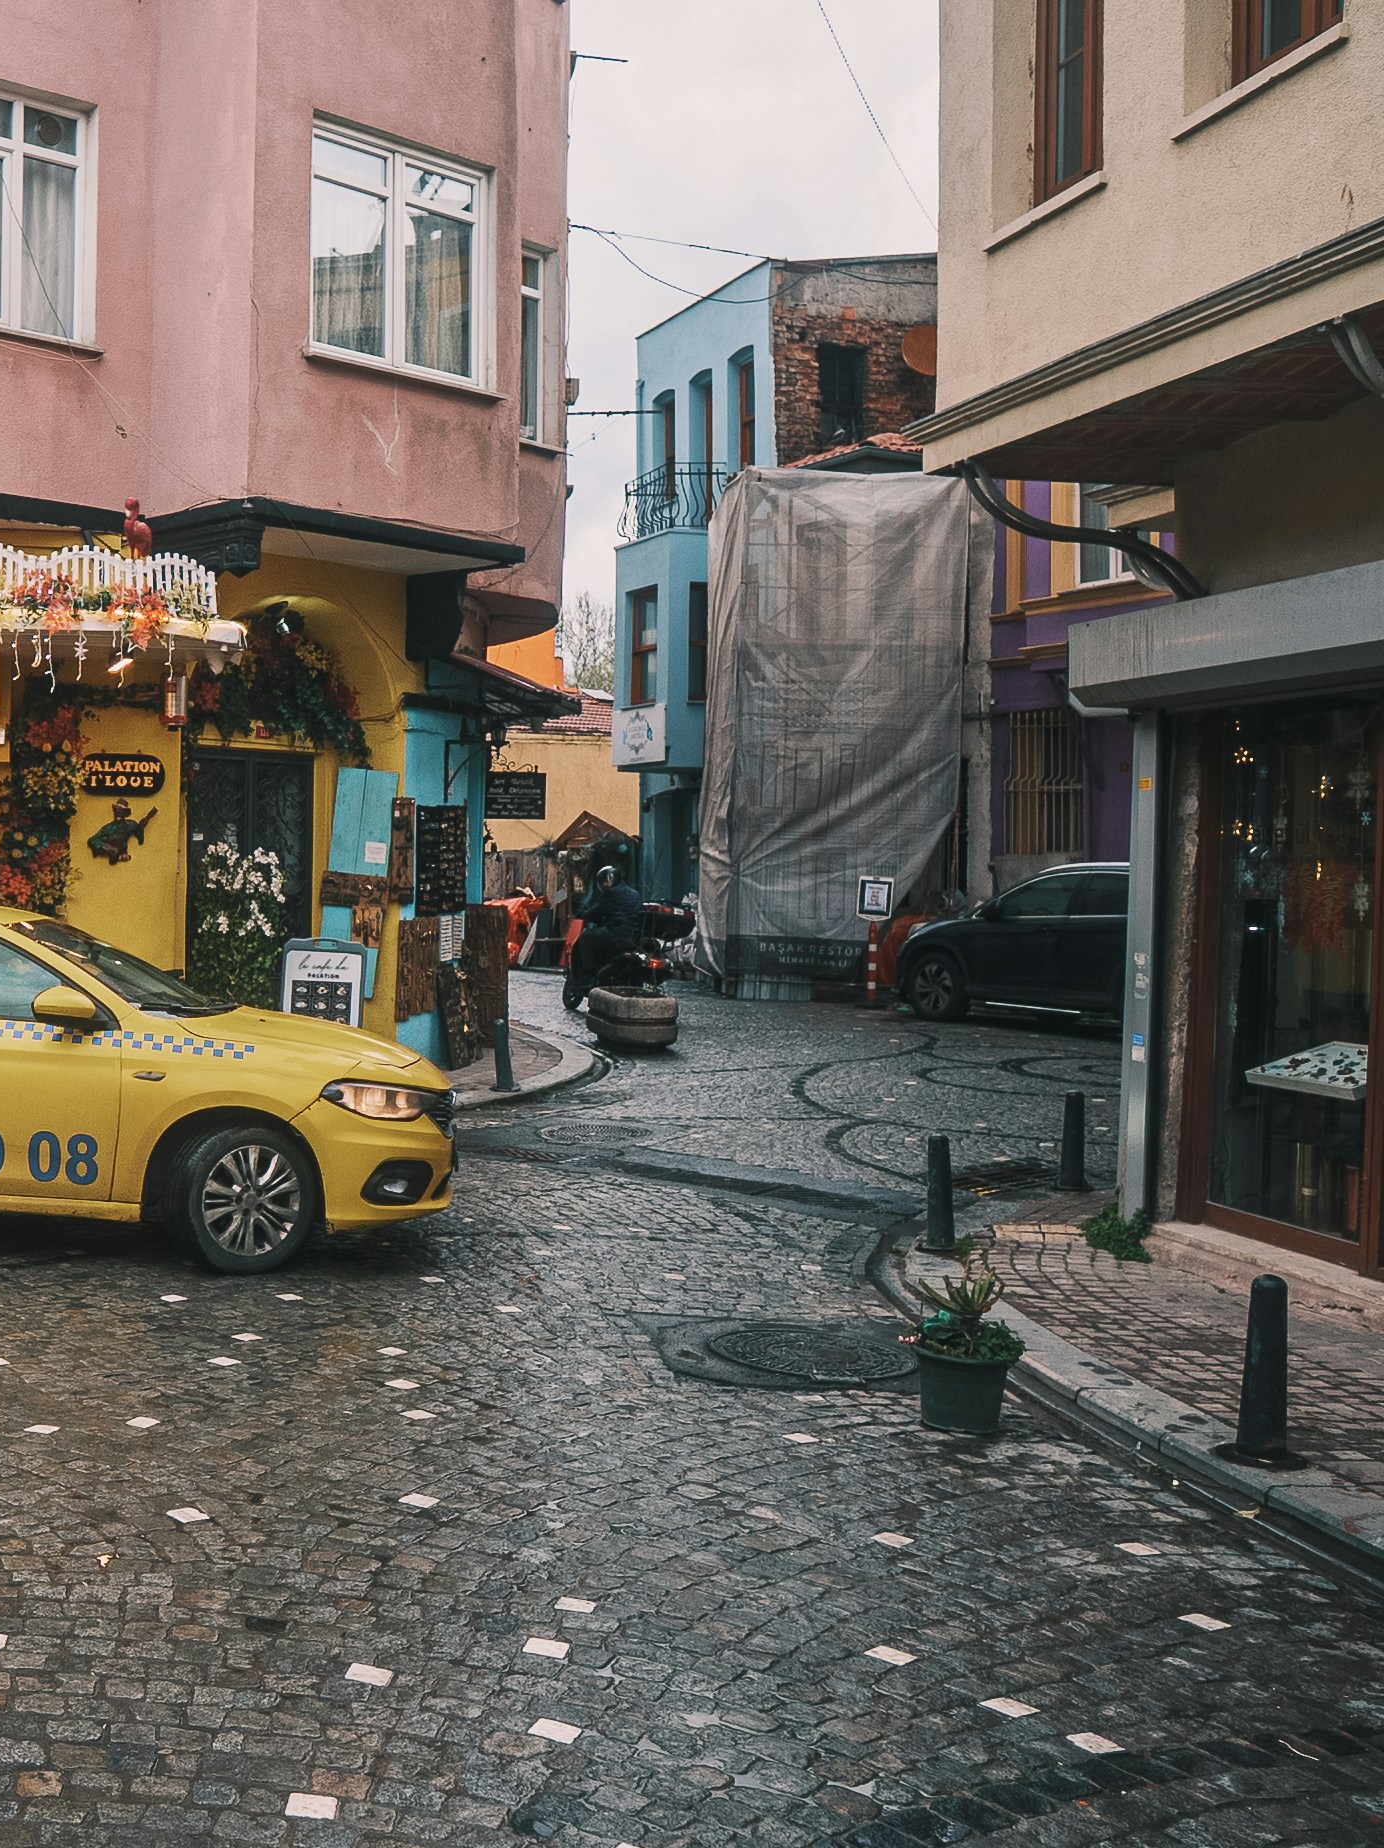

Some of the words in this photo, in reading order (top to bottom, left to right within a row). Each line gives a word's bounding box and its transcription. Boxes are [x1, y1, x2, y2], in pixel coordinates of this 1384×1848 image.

[85, 760, 161, 774] PALATION
[759, 942, 805, 955] BAŞAK
[27, 1130, 99, 1186] 08
